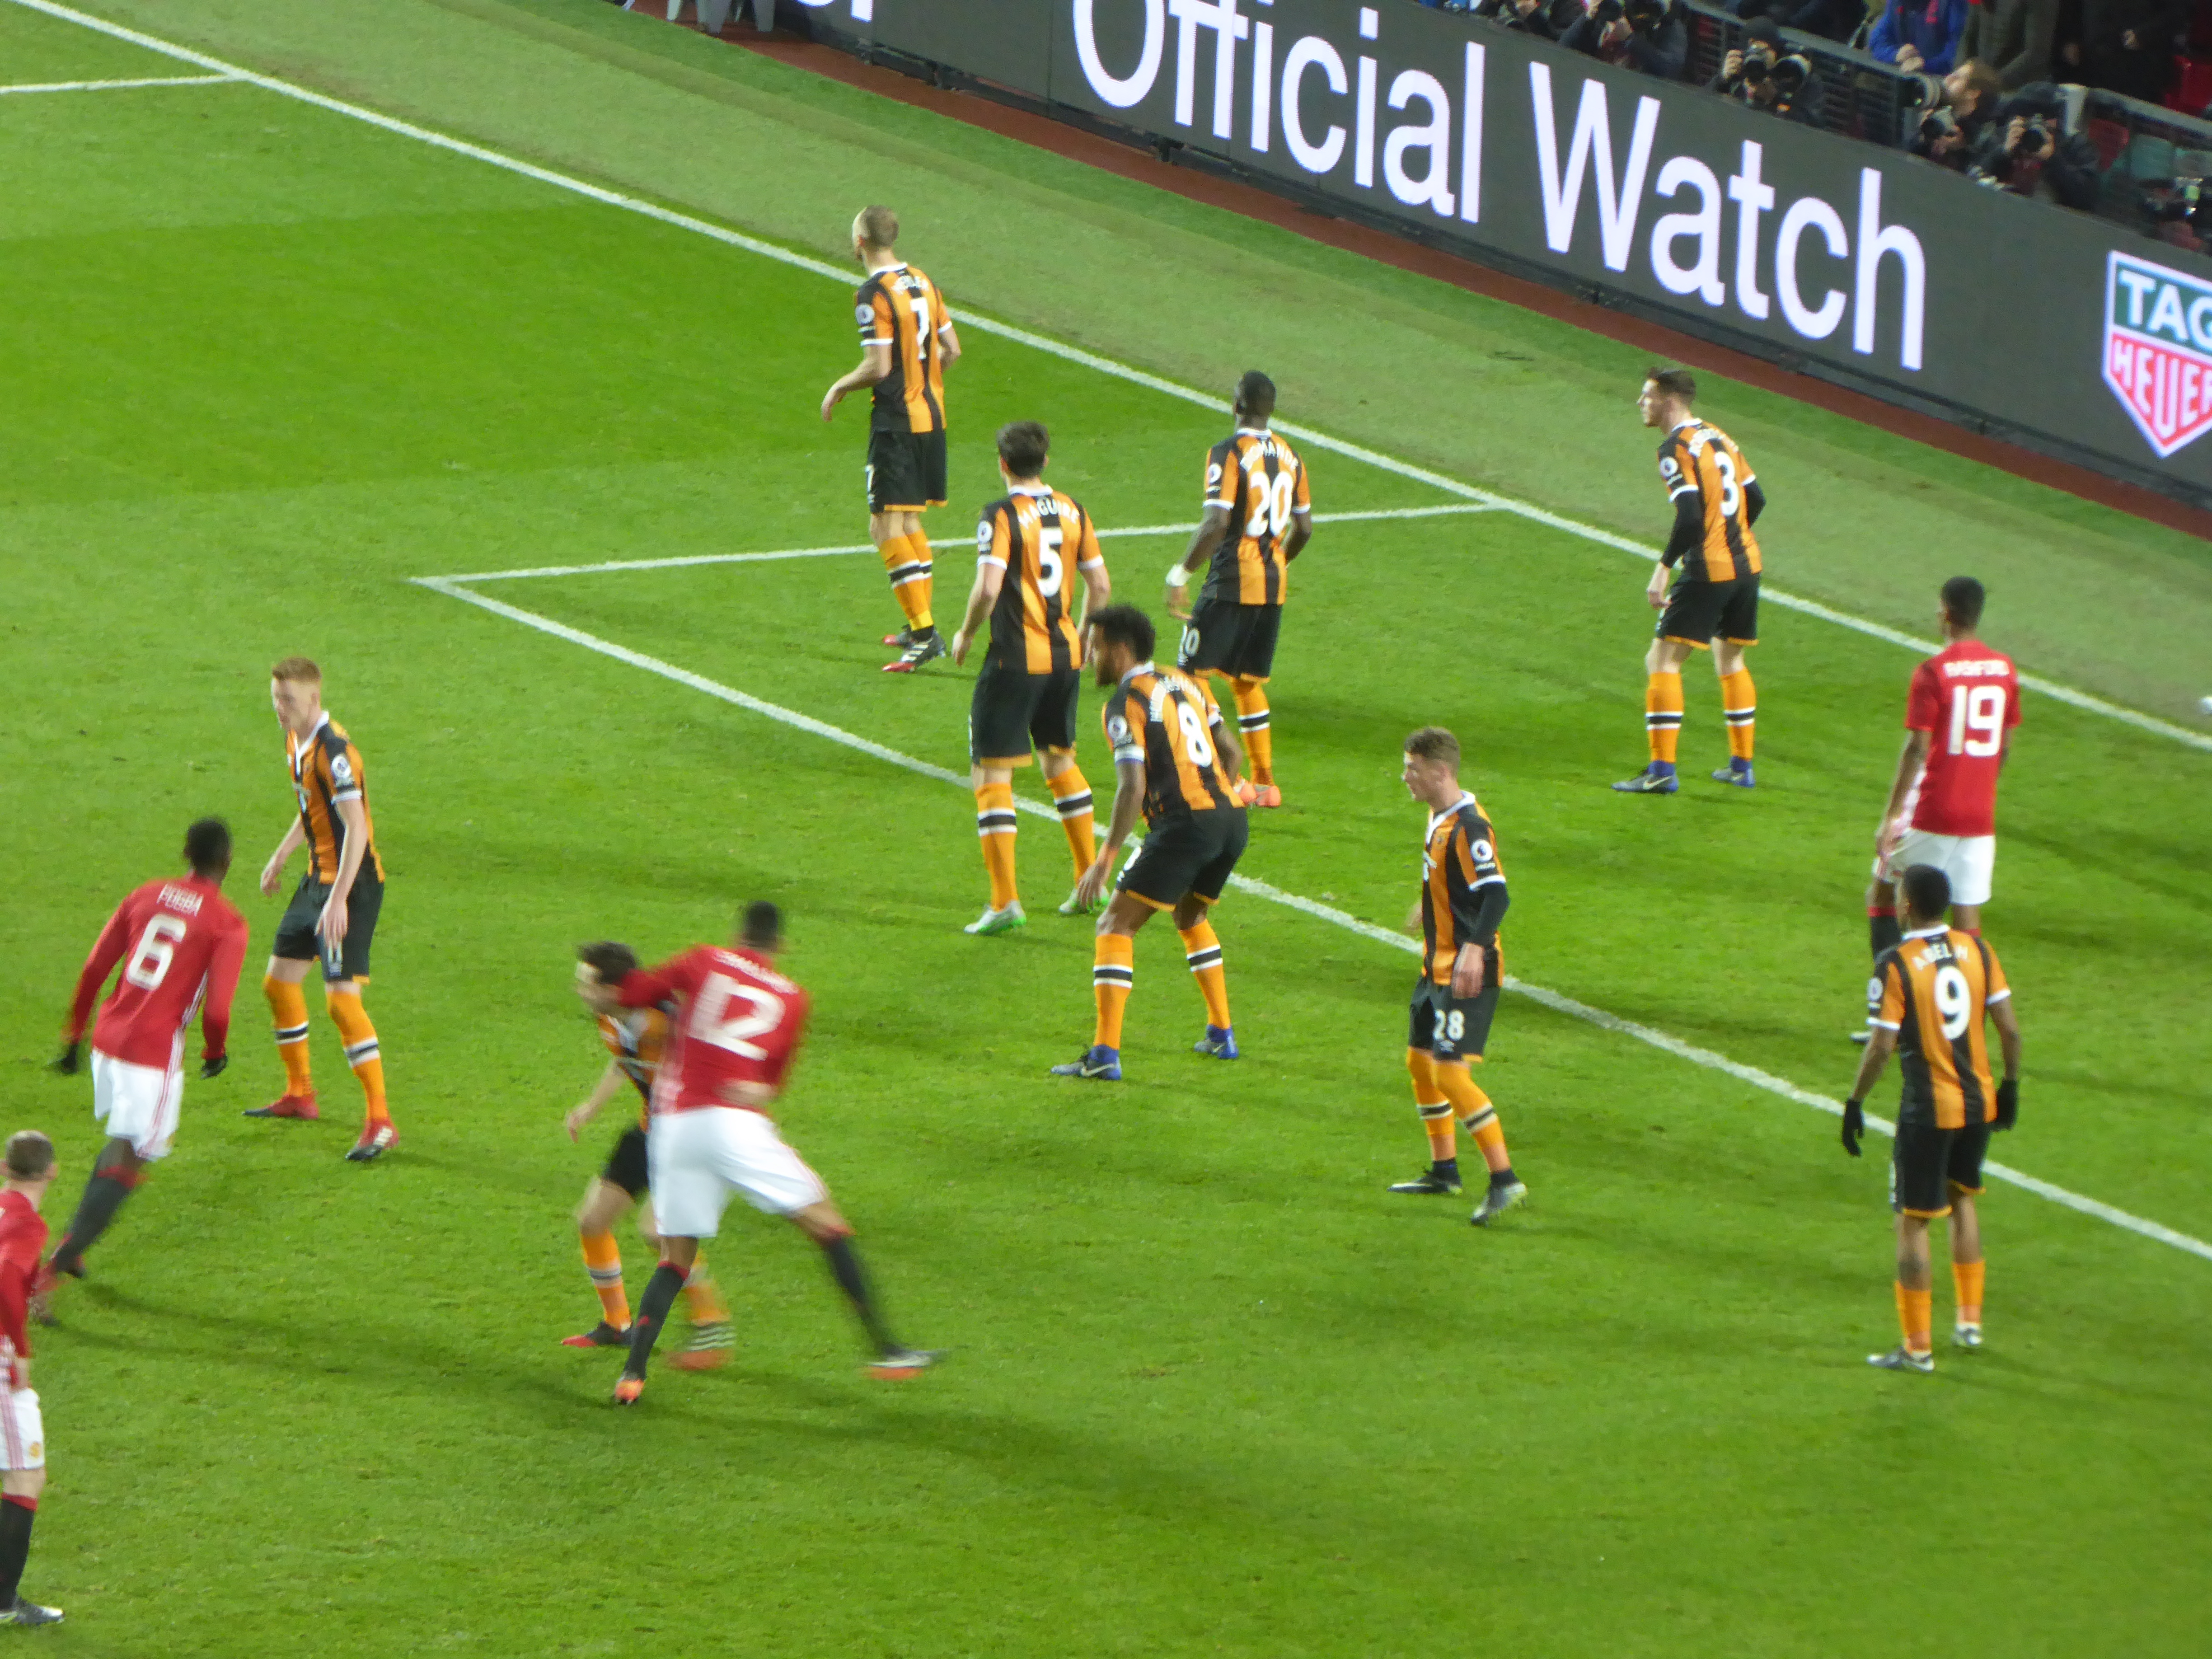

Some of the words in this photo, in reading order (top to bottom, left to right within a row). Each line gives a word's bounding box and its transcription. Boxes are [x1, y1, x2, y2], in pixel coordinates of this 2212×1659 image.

[1072, 0, 1486, 224] Official
[1528, 61, 1926, 370] Watch
[909, 297, 930, 360] 7
[1245, 471, 1294, 537] 20
[1714, 451, 1739, 516] 3
[1036, 527, 1064, 597] 5
[1177, 701, 1212, 768] 8
[1947, 684, 2006, 757] 19
[127, 912, 187, 992] 6
[687, 970, 786, 1061] 12
[1432, 1009, 1465, 1041] 28
[1934, 965, 1971, 1040] 9
